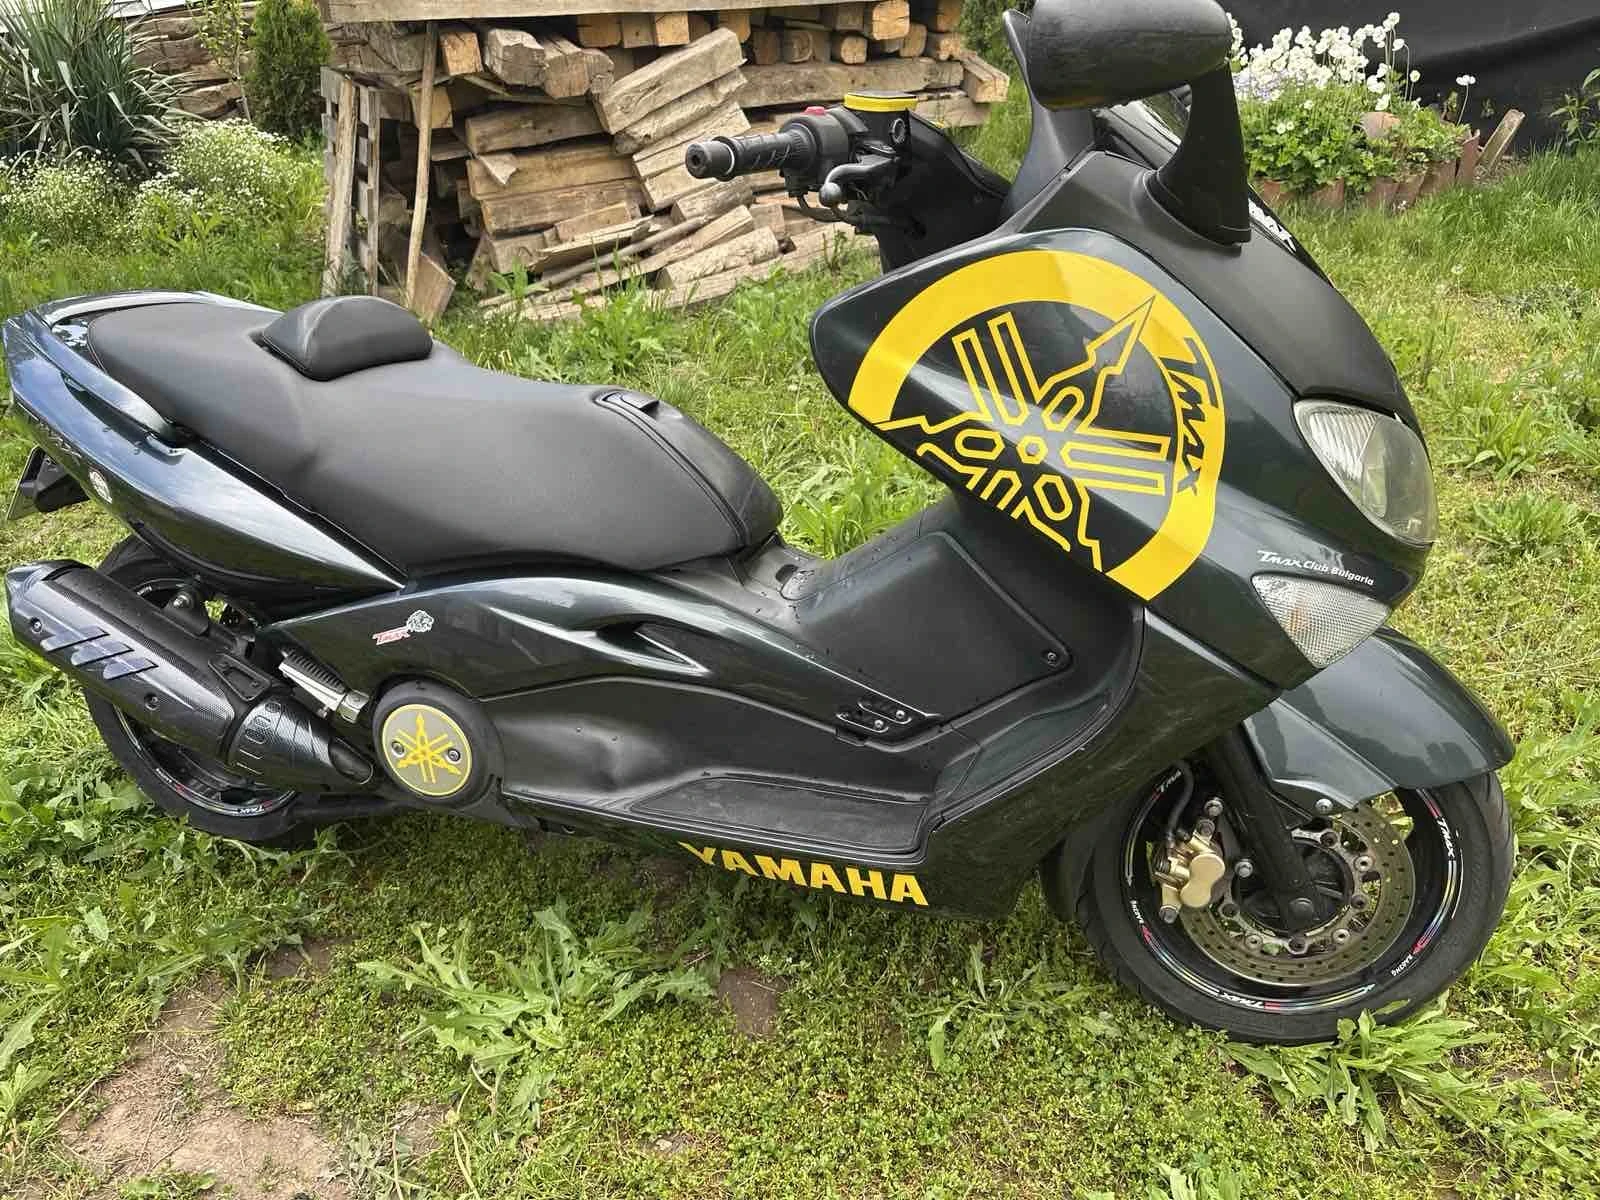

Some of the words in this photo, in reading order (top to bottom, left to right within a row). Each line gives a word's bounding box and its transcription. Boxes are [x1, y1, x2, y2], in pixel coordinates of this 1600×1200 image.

[1303, 560, 1329, 573] Club
[1330, 567, 1375, 586] Bulgaria
[677, 840, 929, 906] YAMAHA
